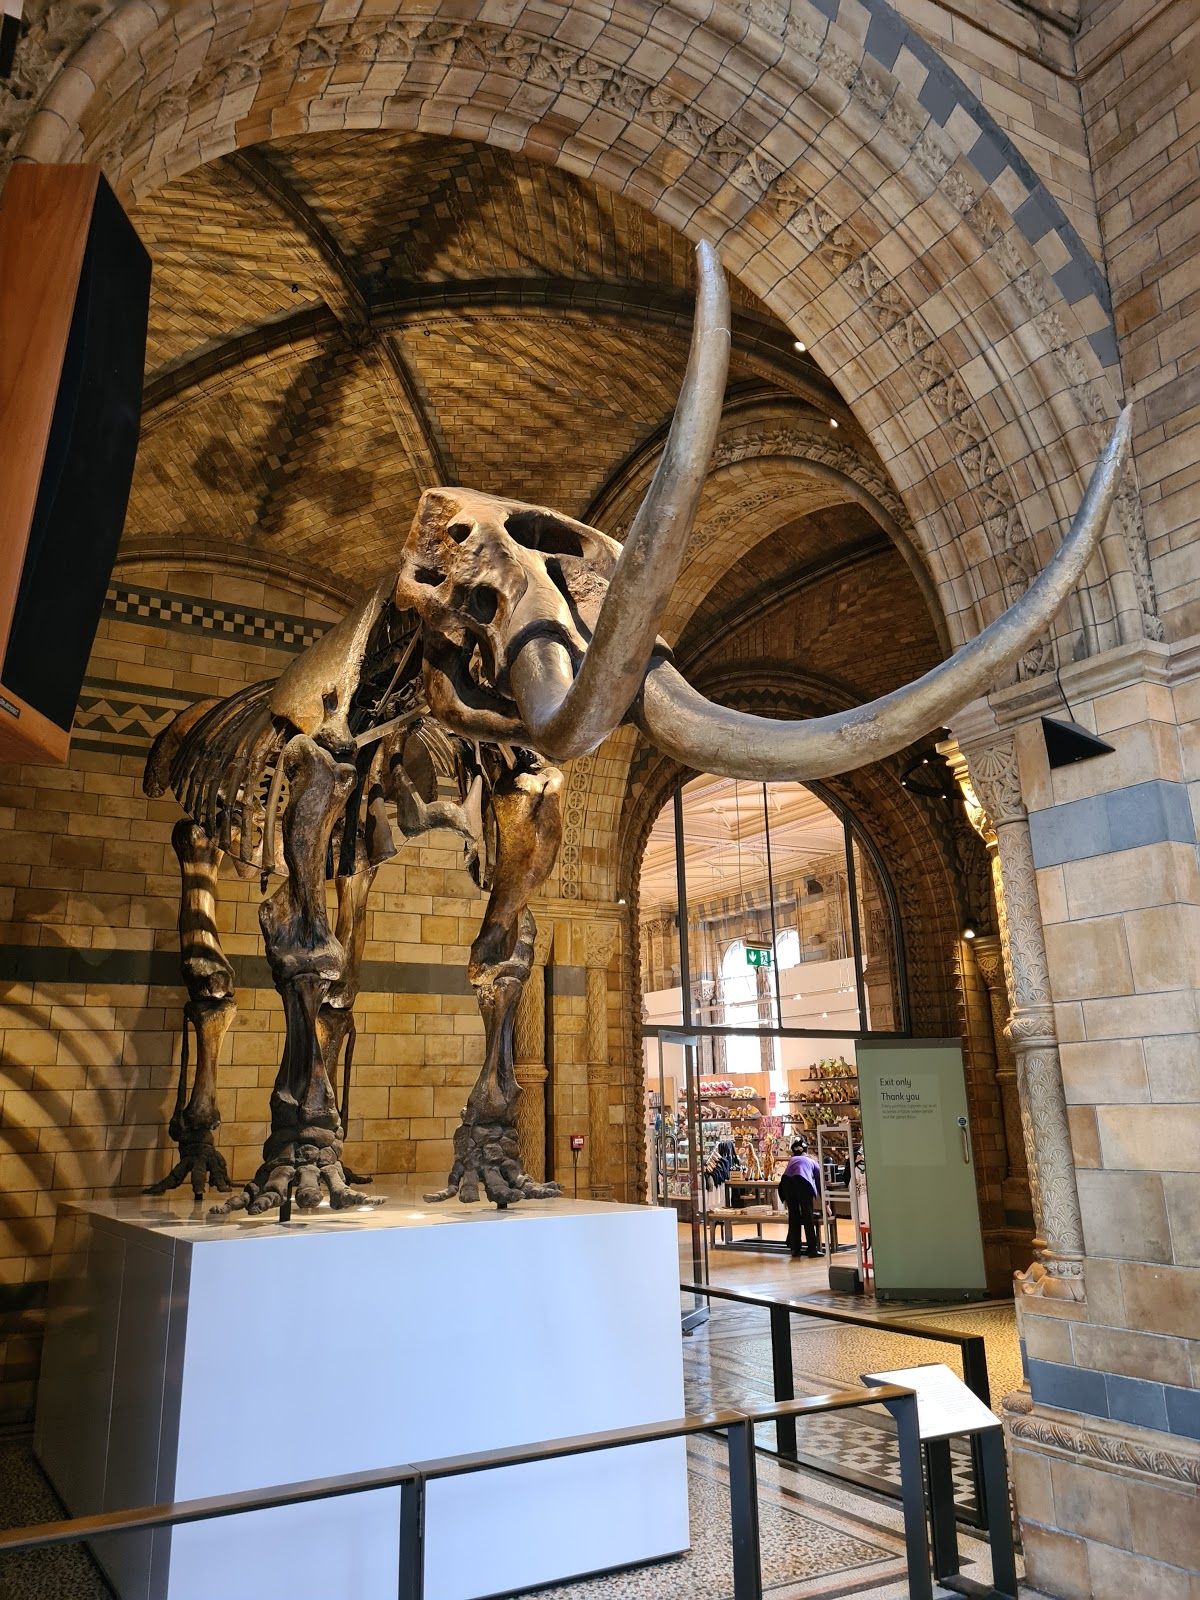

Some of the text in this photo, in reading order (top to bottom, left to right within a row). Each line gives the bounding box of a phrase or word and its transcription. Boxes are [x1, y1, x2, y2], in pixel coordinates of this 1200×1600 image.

[880, 1077, 912, 1088] Exit only
[881, 1092, 920, 1102] Thank you
